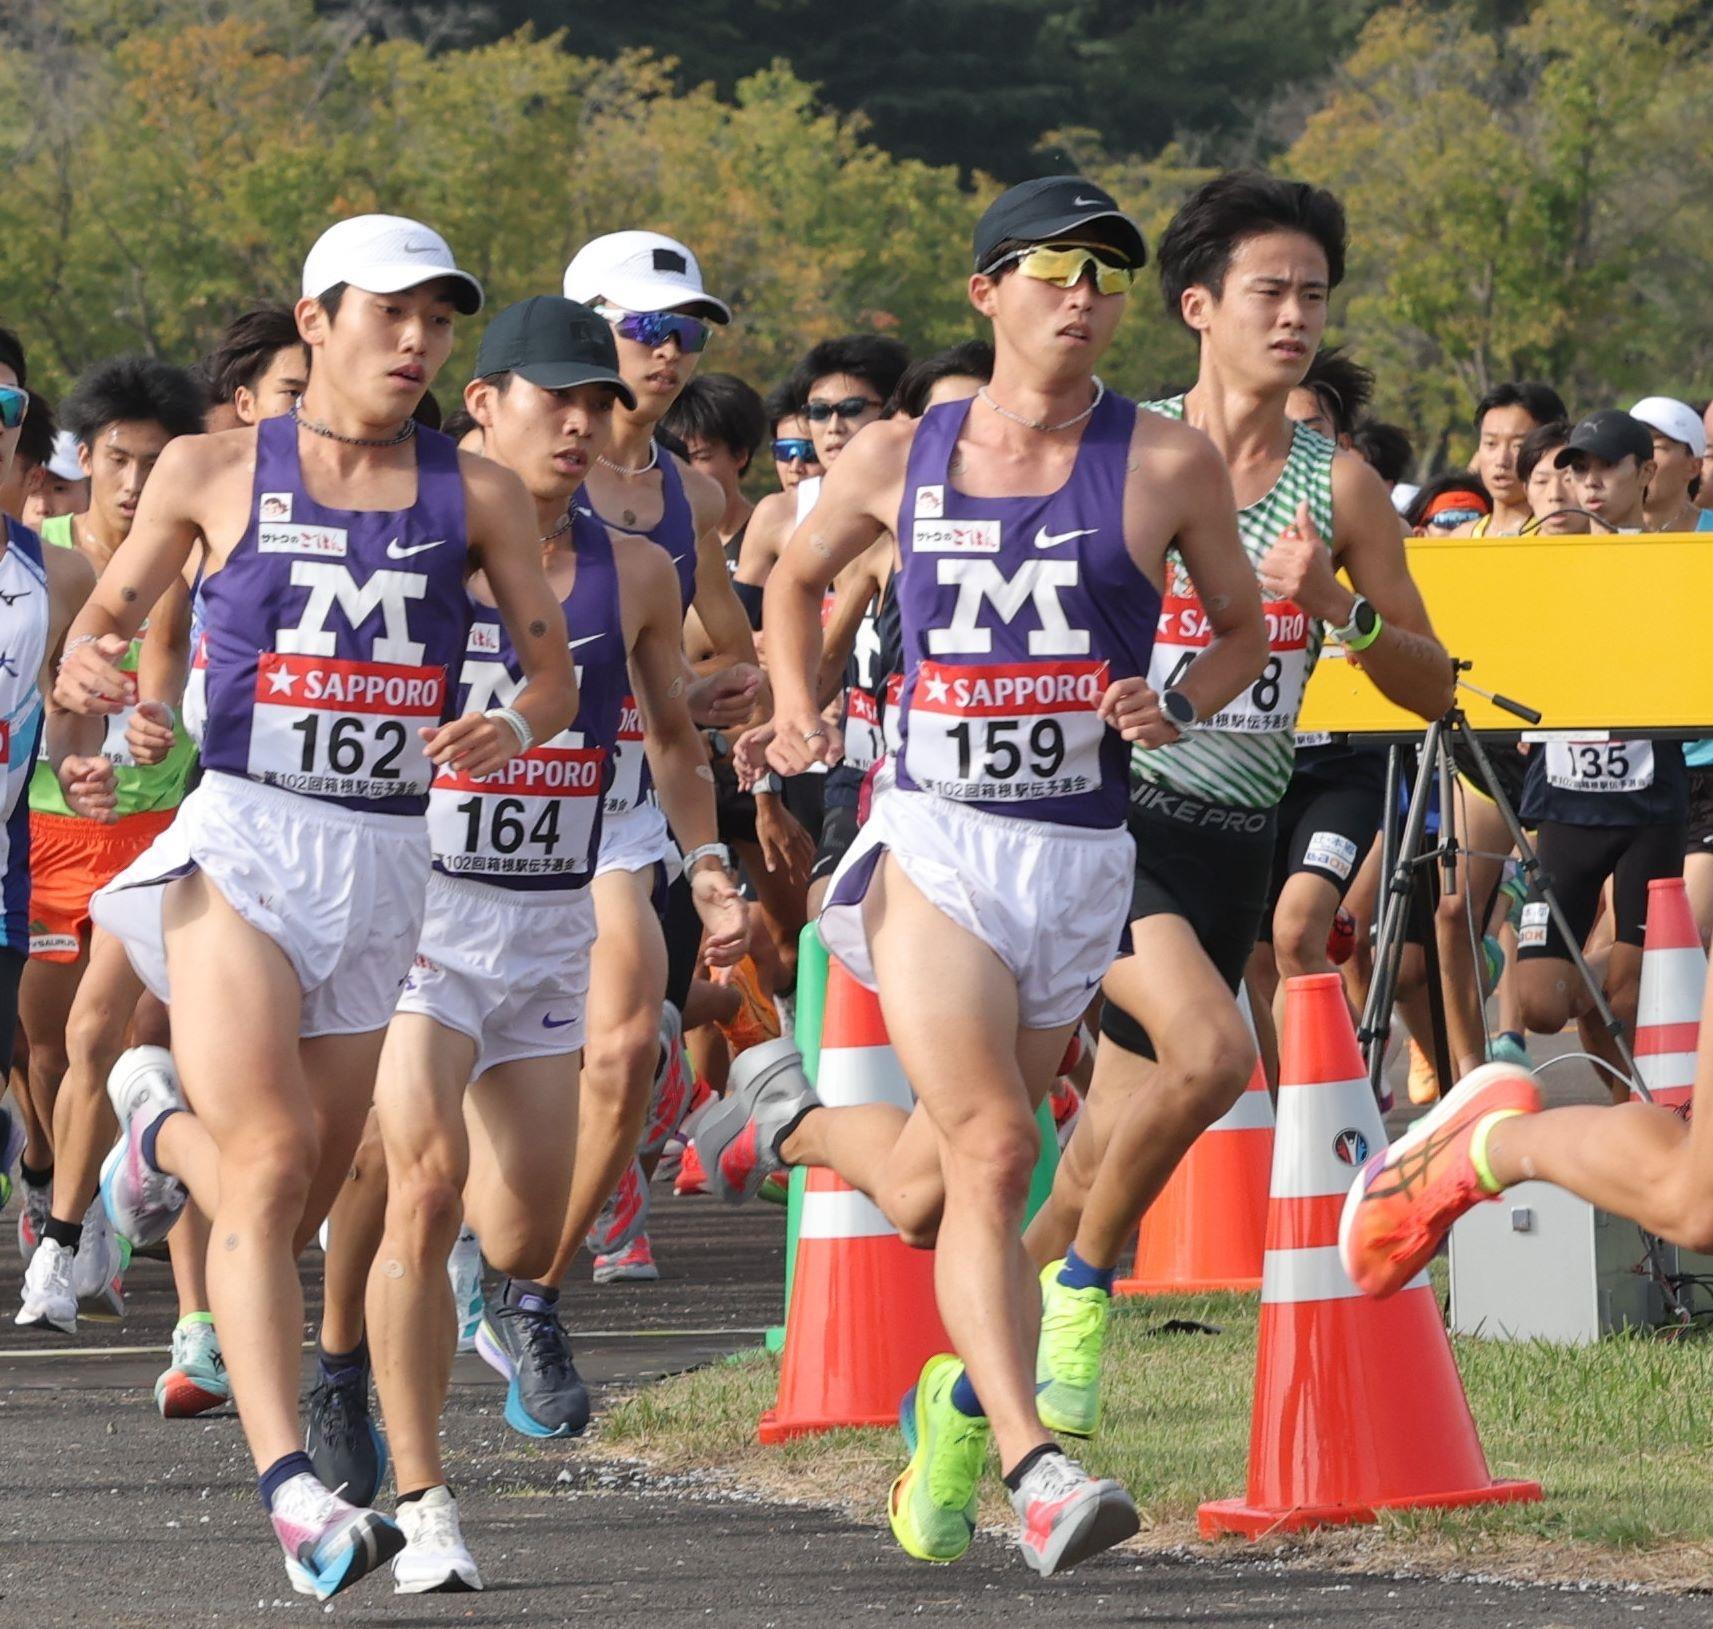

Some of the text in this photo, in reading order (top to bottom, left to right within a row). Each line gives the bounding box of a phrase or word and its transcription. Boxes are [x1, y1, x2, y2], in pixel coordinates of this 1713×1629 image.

[275, 560, 428, 667] M
[928, 559, 1090, 656] M
[1179, 609, 1304, 642] SAORO
[303, 670, 438, 708] SAPPORO
[953, 674, 1098, 708] SAPPORO
[292, 713, 407, 779] 162
[946, 718, 1065, 780] 159
[1568, 744, 1629, 779] 135
[457, 796, 560, 856] 164
[1198, 807, 1267, 833] PRO
[440, 853, 576, 873] 102回箱根駅伝予選会
